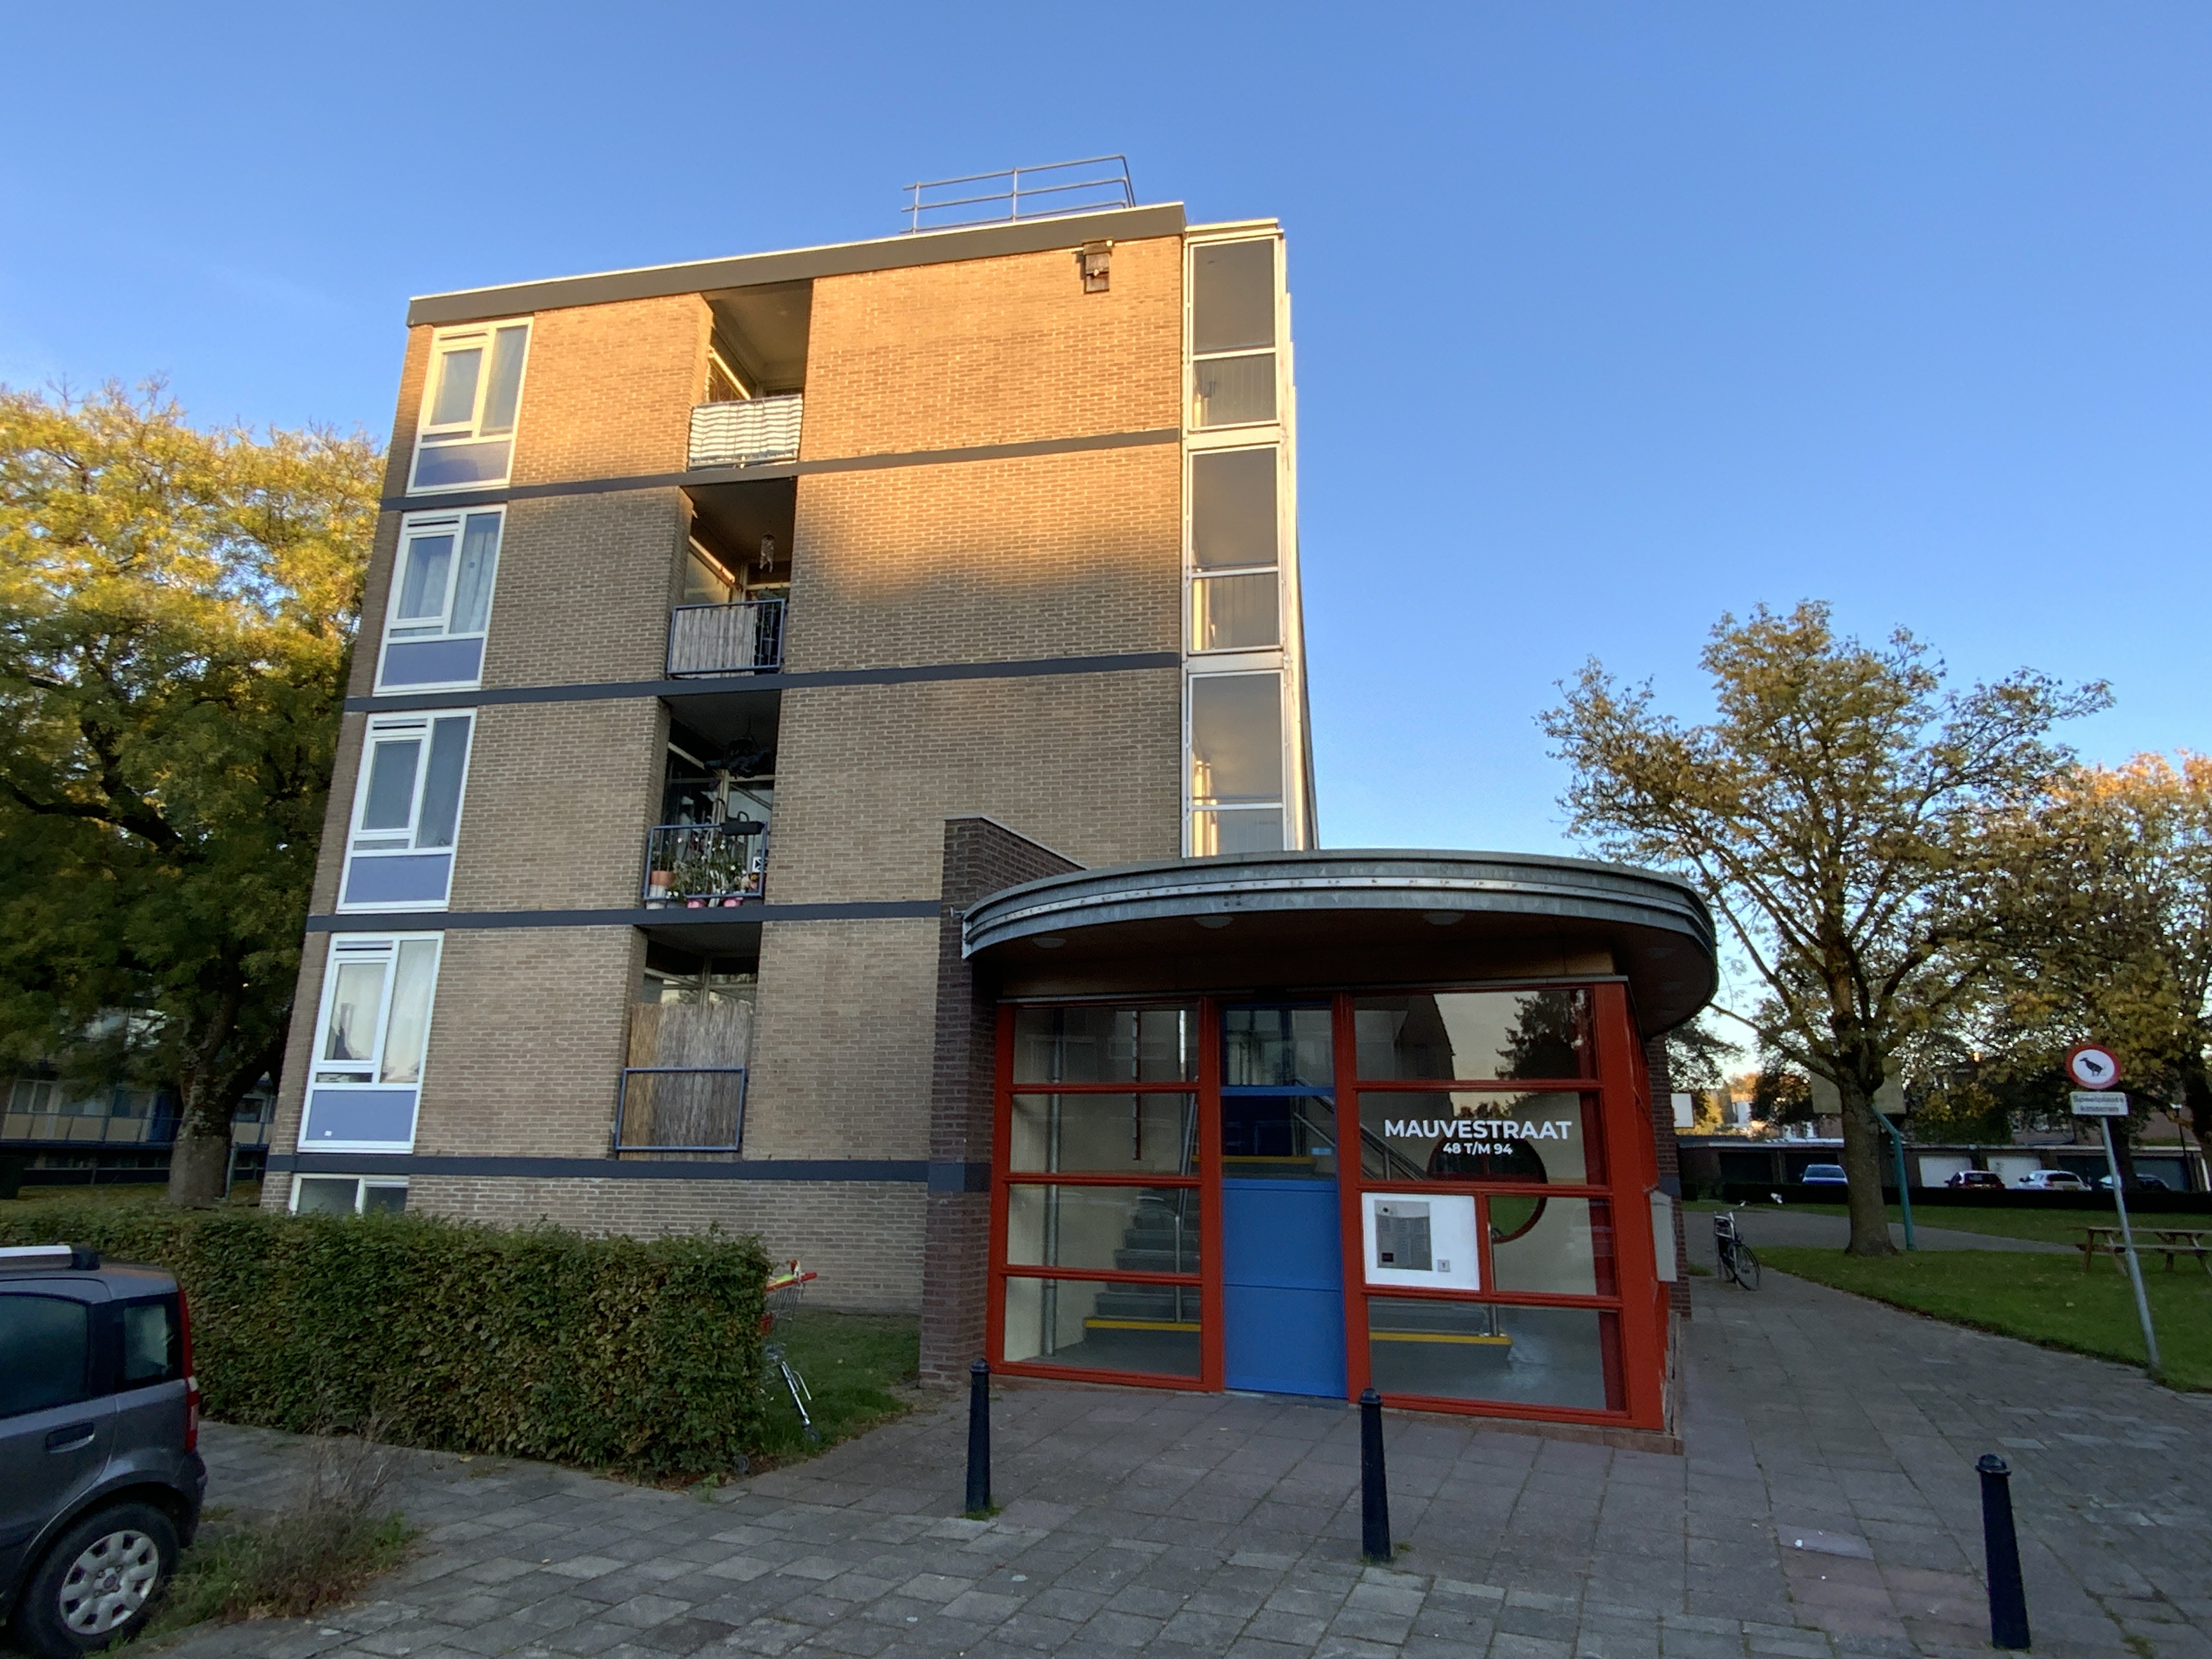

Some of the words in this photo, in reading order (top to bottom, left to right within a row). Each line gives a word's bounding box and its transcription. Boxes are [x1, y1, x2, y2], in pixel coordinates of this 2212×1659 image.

[1385, 1120, 1572, 1139] MAUVESTRAAT
[1443, 1143, 1461, 1154] 48
[1464, 1142, 1490, 1155] T/M
[1493, 1143, 1513, 1155] 94
